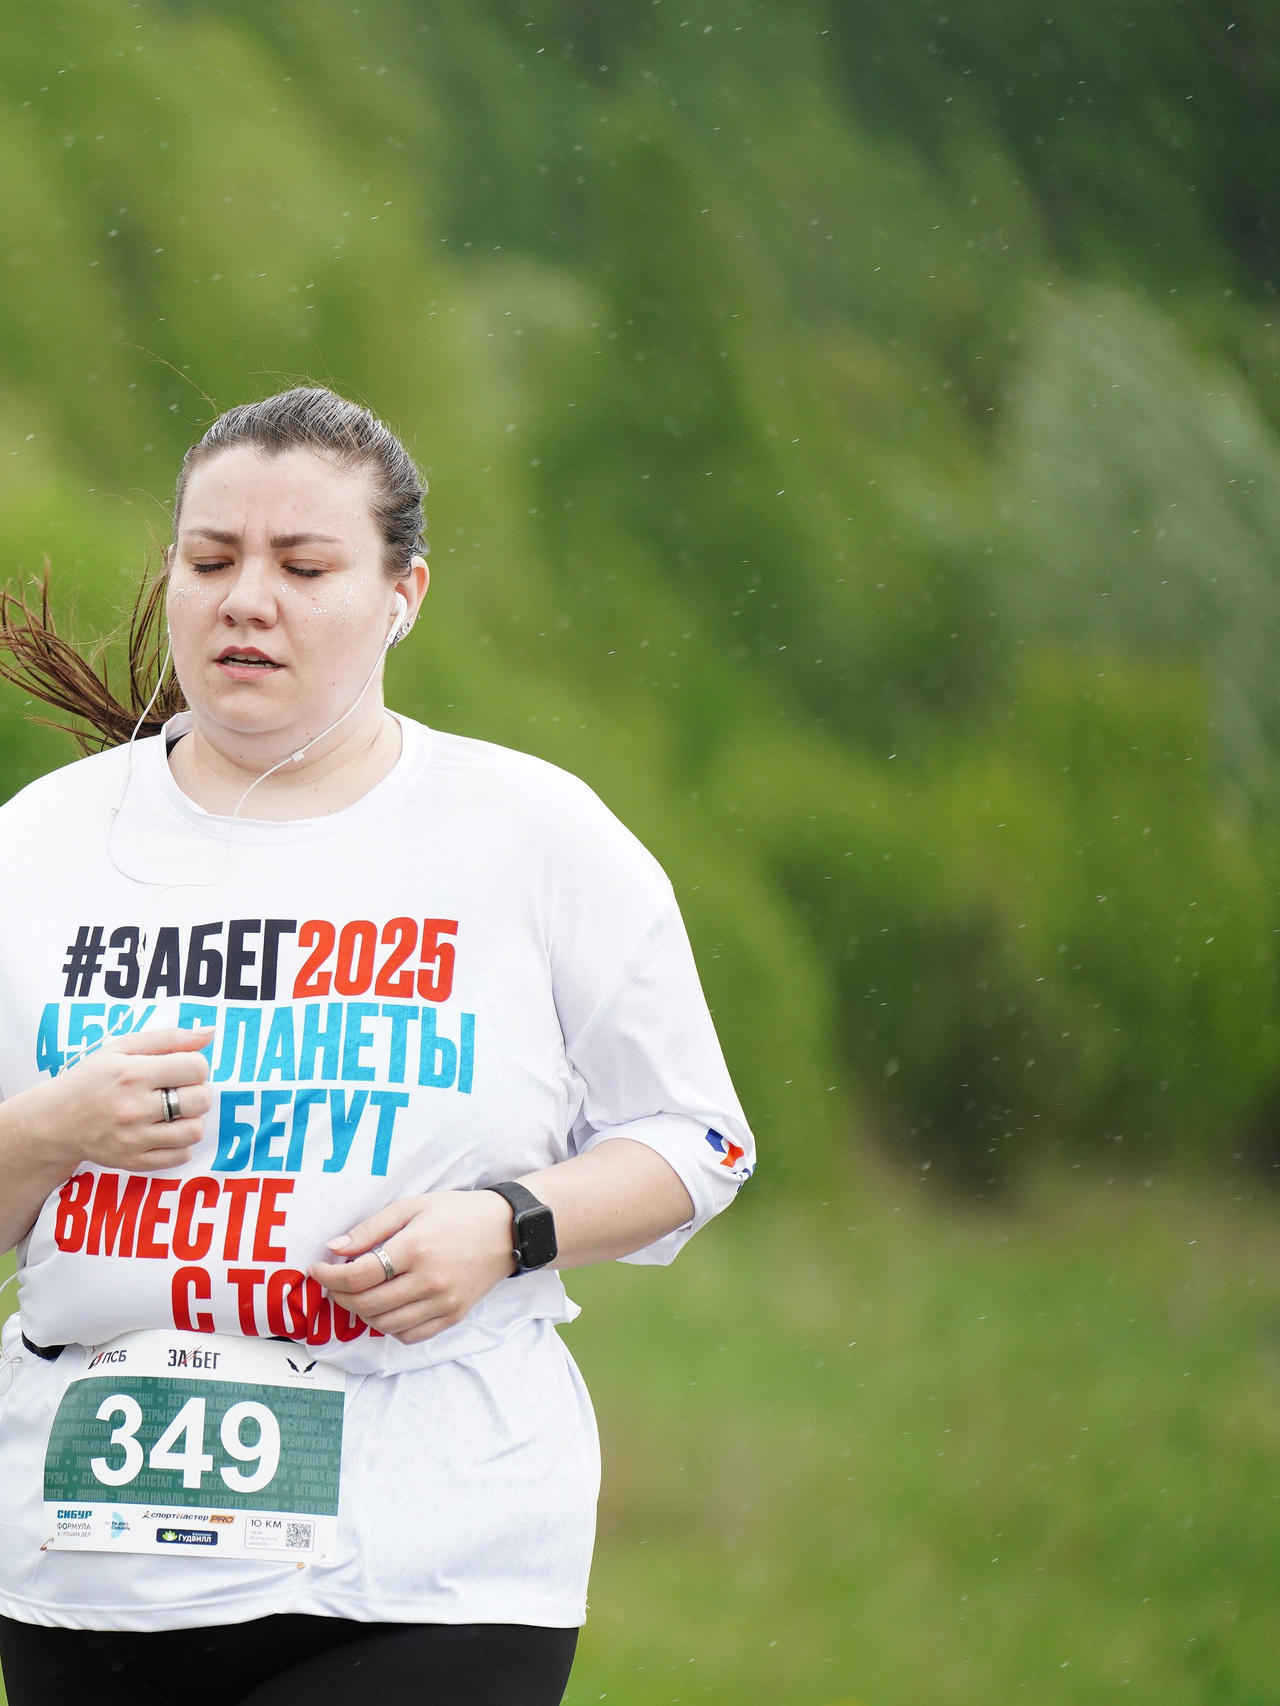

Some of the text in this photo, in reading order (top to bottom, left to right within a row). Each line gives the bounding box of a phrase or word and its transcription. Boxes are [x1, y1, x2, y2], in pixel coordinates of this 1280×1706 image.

[62, 917, 459, 1002] #ЗАБЕГ2025
[210, 1087, 410, 1177] БЕГУТ
[54, 1171, 296, 1263] ВМЕСТЕ
[171, 1262, 386, 1346] С ТОБ
[102, 1349, 127, 1365] ПСБ
[157, 1378, 196, 1391] БЕГОВАЯ
[91, 1394, 281, 1493] 349
[140, 1474, 173, 1488] ОТСТАЛ
[76, 1488, 107, 1502] ФИНИШ
[116, 1490, 150, 1504] ТОЛЬКО
[150, 1491, 185, 1506] НАЧАЛО
[211, 1495, 246, 1509] СТАРТЕ
[246, 1497, 279, 1511] ЖИЗНИ
[57, 1509, 93, 1520] СИБУР
[210, 1515, 234, 1524] PRO
[56, 1522, 92, 1531] ФОРМУЛА
[251, 1518, 262, 1528] 10
